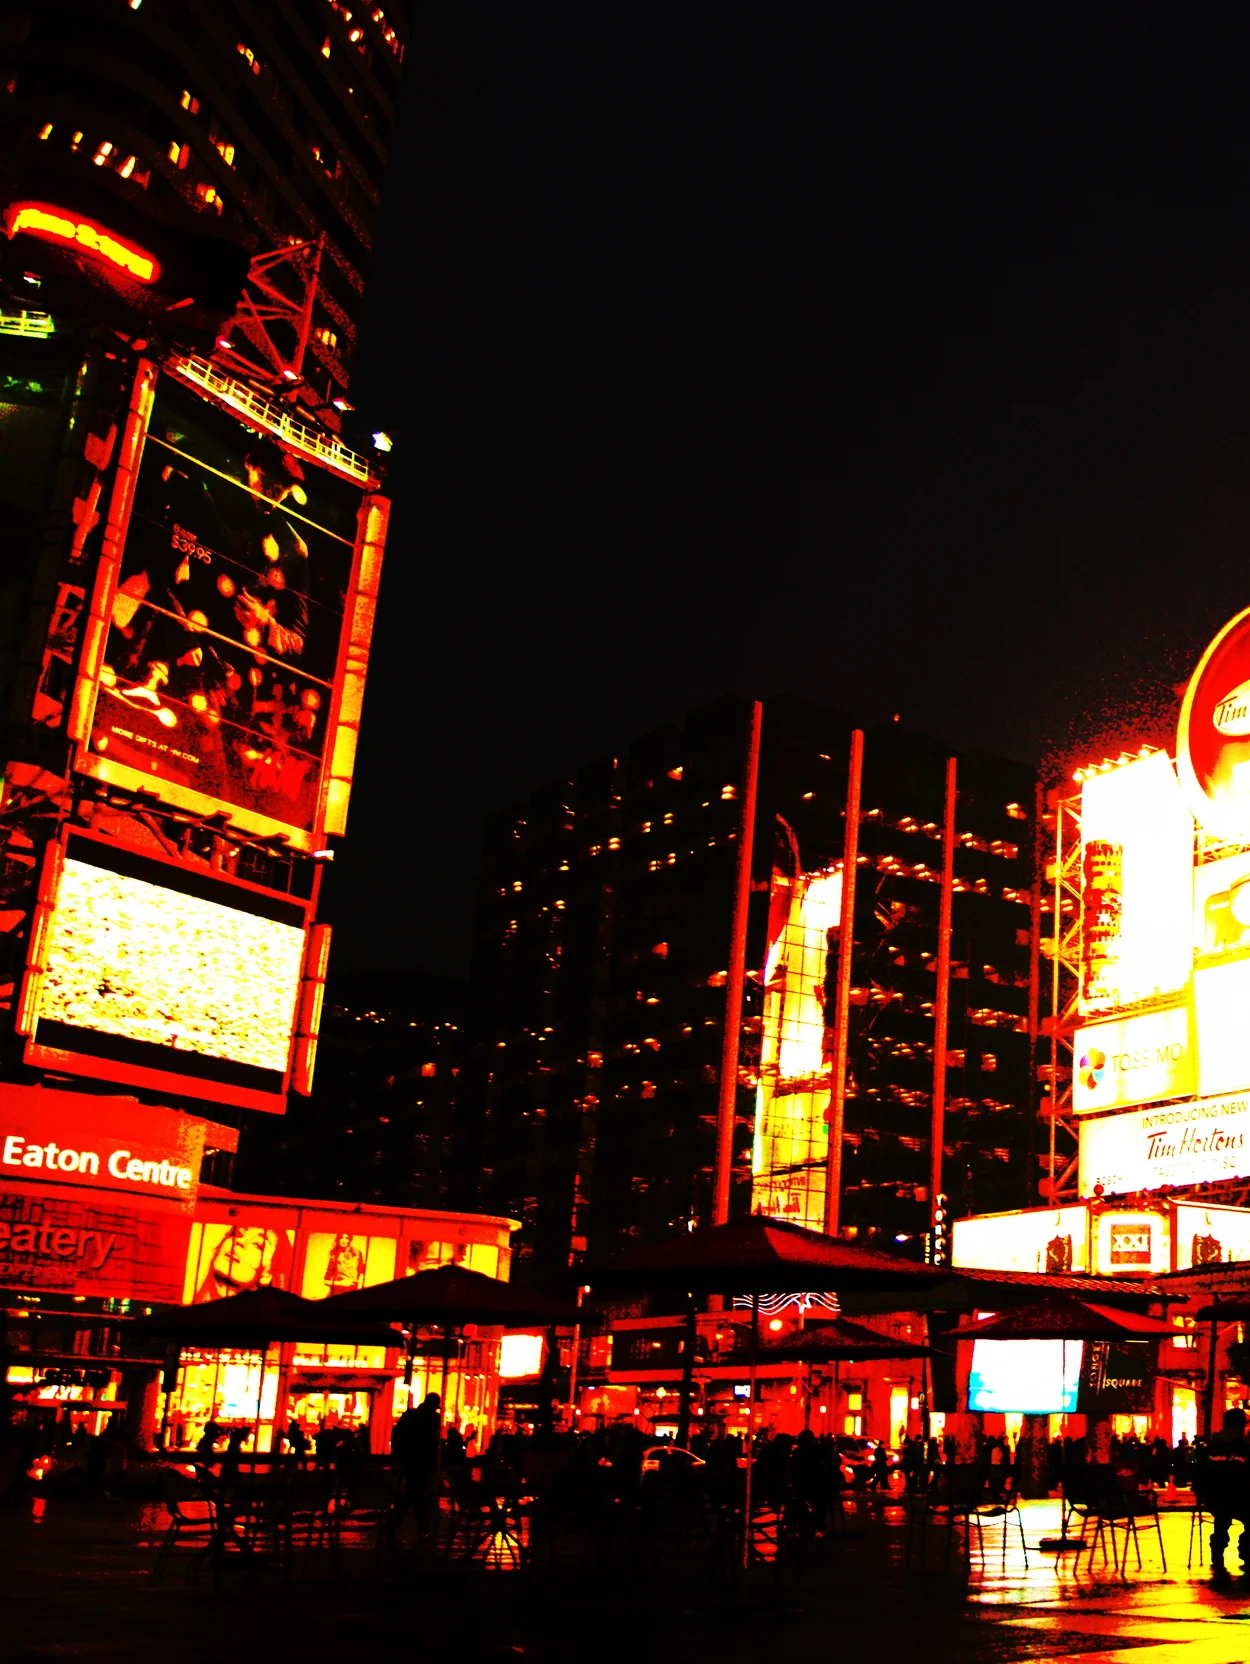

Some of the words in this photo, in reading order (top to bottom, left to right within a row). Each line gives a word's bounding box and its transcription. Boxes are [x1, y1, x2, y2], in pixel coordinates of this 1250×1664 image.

[171, 534, 212, 564] $39.95
[1216, 695, 1248, 726] Tim
[158, 744, 169, 752] AT
[1110, 1043, 1182, 1073] TOSSMO
[1142, 1105, 1219, 1129] INTRODUCING
[1220, 1099, 1249, 1117] NEW
[1147, 1131, 1177, 1160] Tim
[1179, 1127, 1244, 1155] Hortons
[2, 1135, 100, 1176] Eaton
[107, 1149, 193, 1190] Centre
[1112, 1234, 1149, 1252] XXI
[1105, 1378, 1143, 1389] SQUARE
